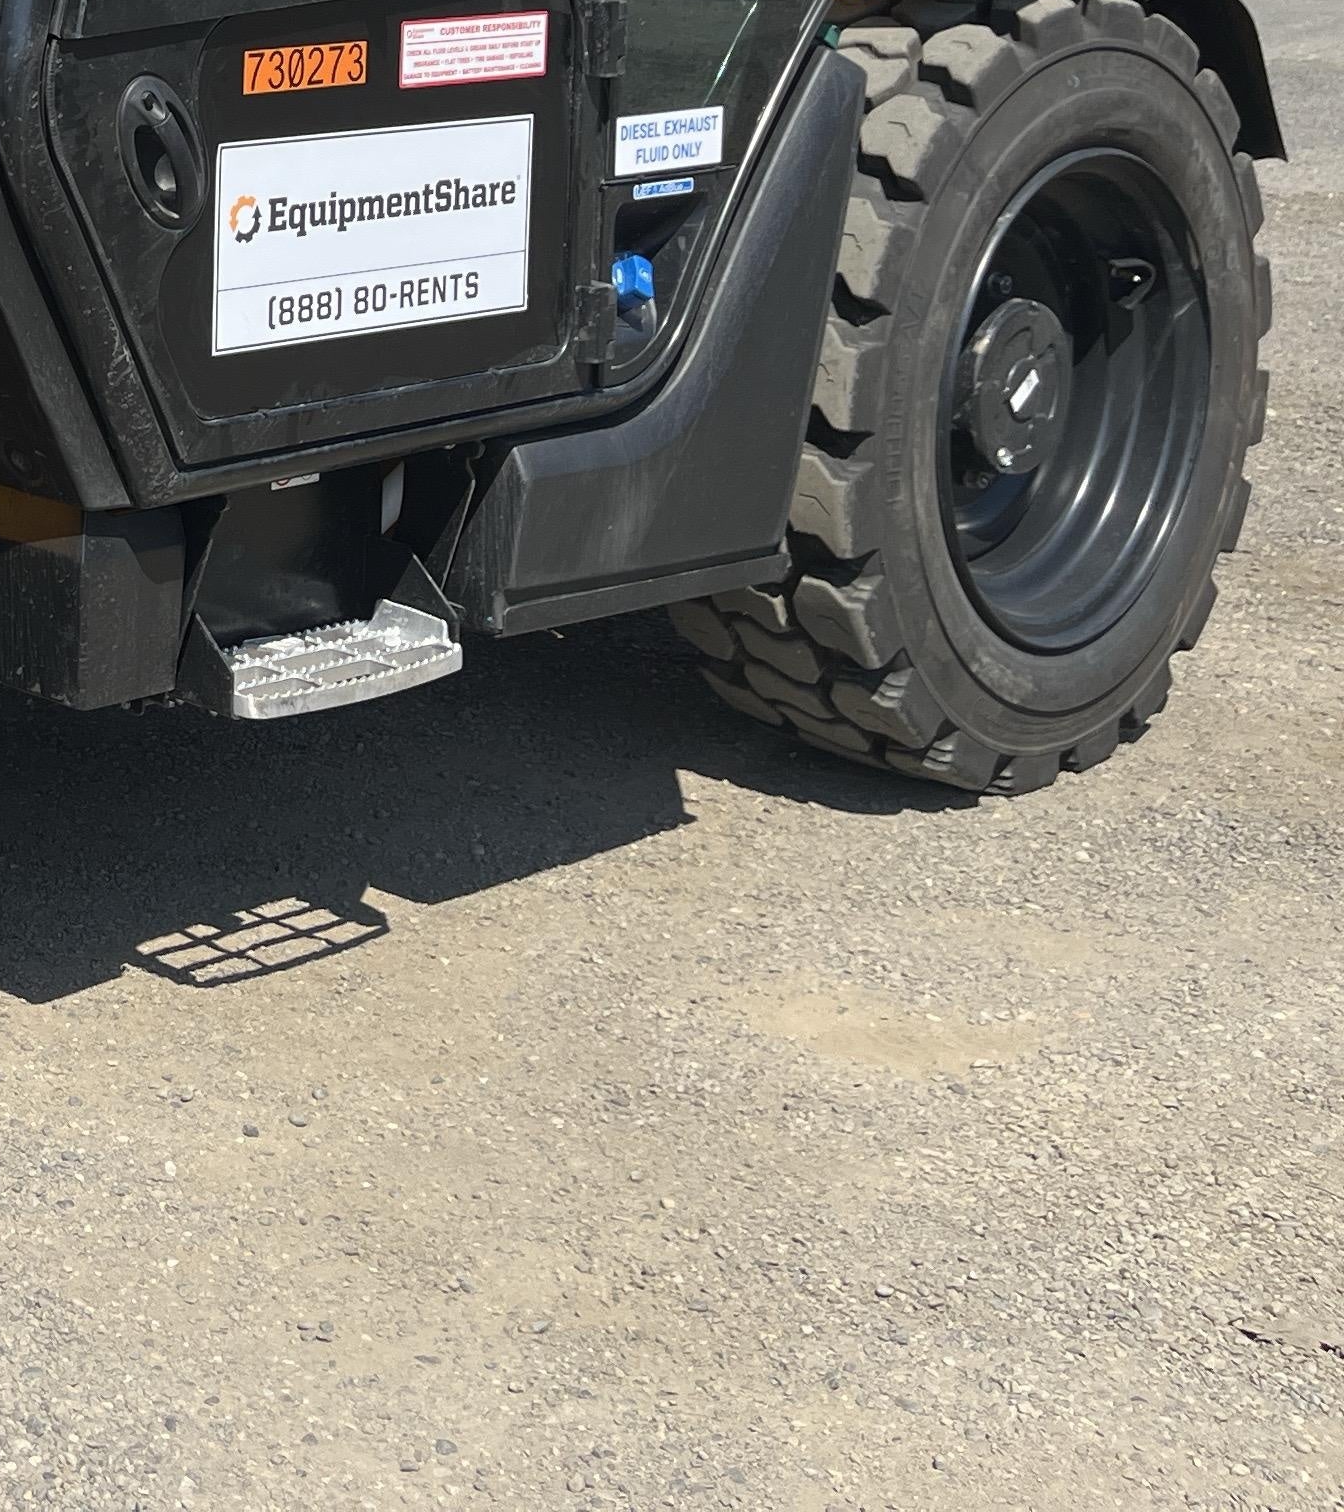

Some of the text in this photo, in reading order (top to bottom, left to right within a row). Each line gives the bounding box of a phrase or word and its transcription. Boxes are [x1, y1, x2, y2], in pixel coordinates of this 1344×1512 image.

[439, 23, 481, 35] CUSTOMER
[481, 18, 541, 32] RESPONSIBILITY
[247, 43, 363, 92] 730273
[620, 115, 719, 141] DIESEL EXHAUST
[635, 141, 703, 165] FLUID ONLY
[267, 177, 517, 238] EquipmentShare
[268, 271, 480, 329] (888) 80-RENTS
